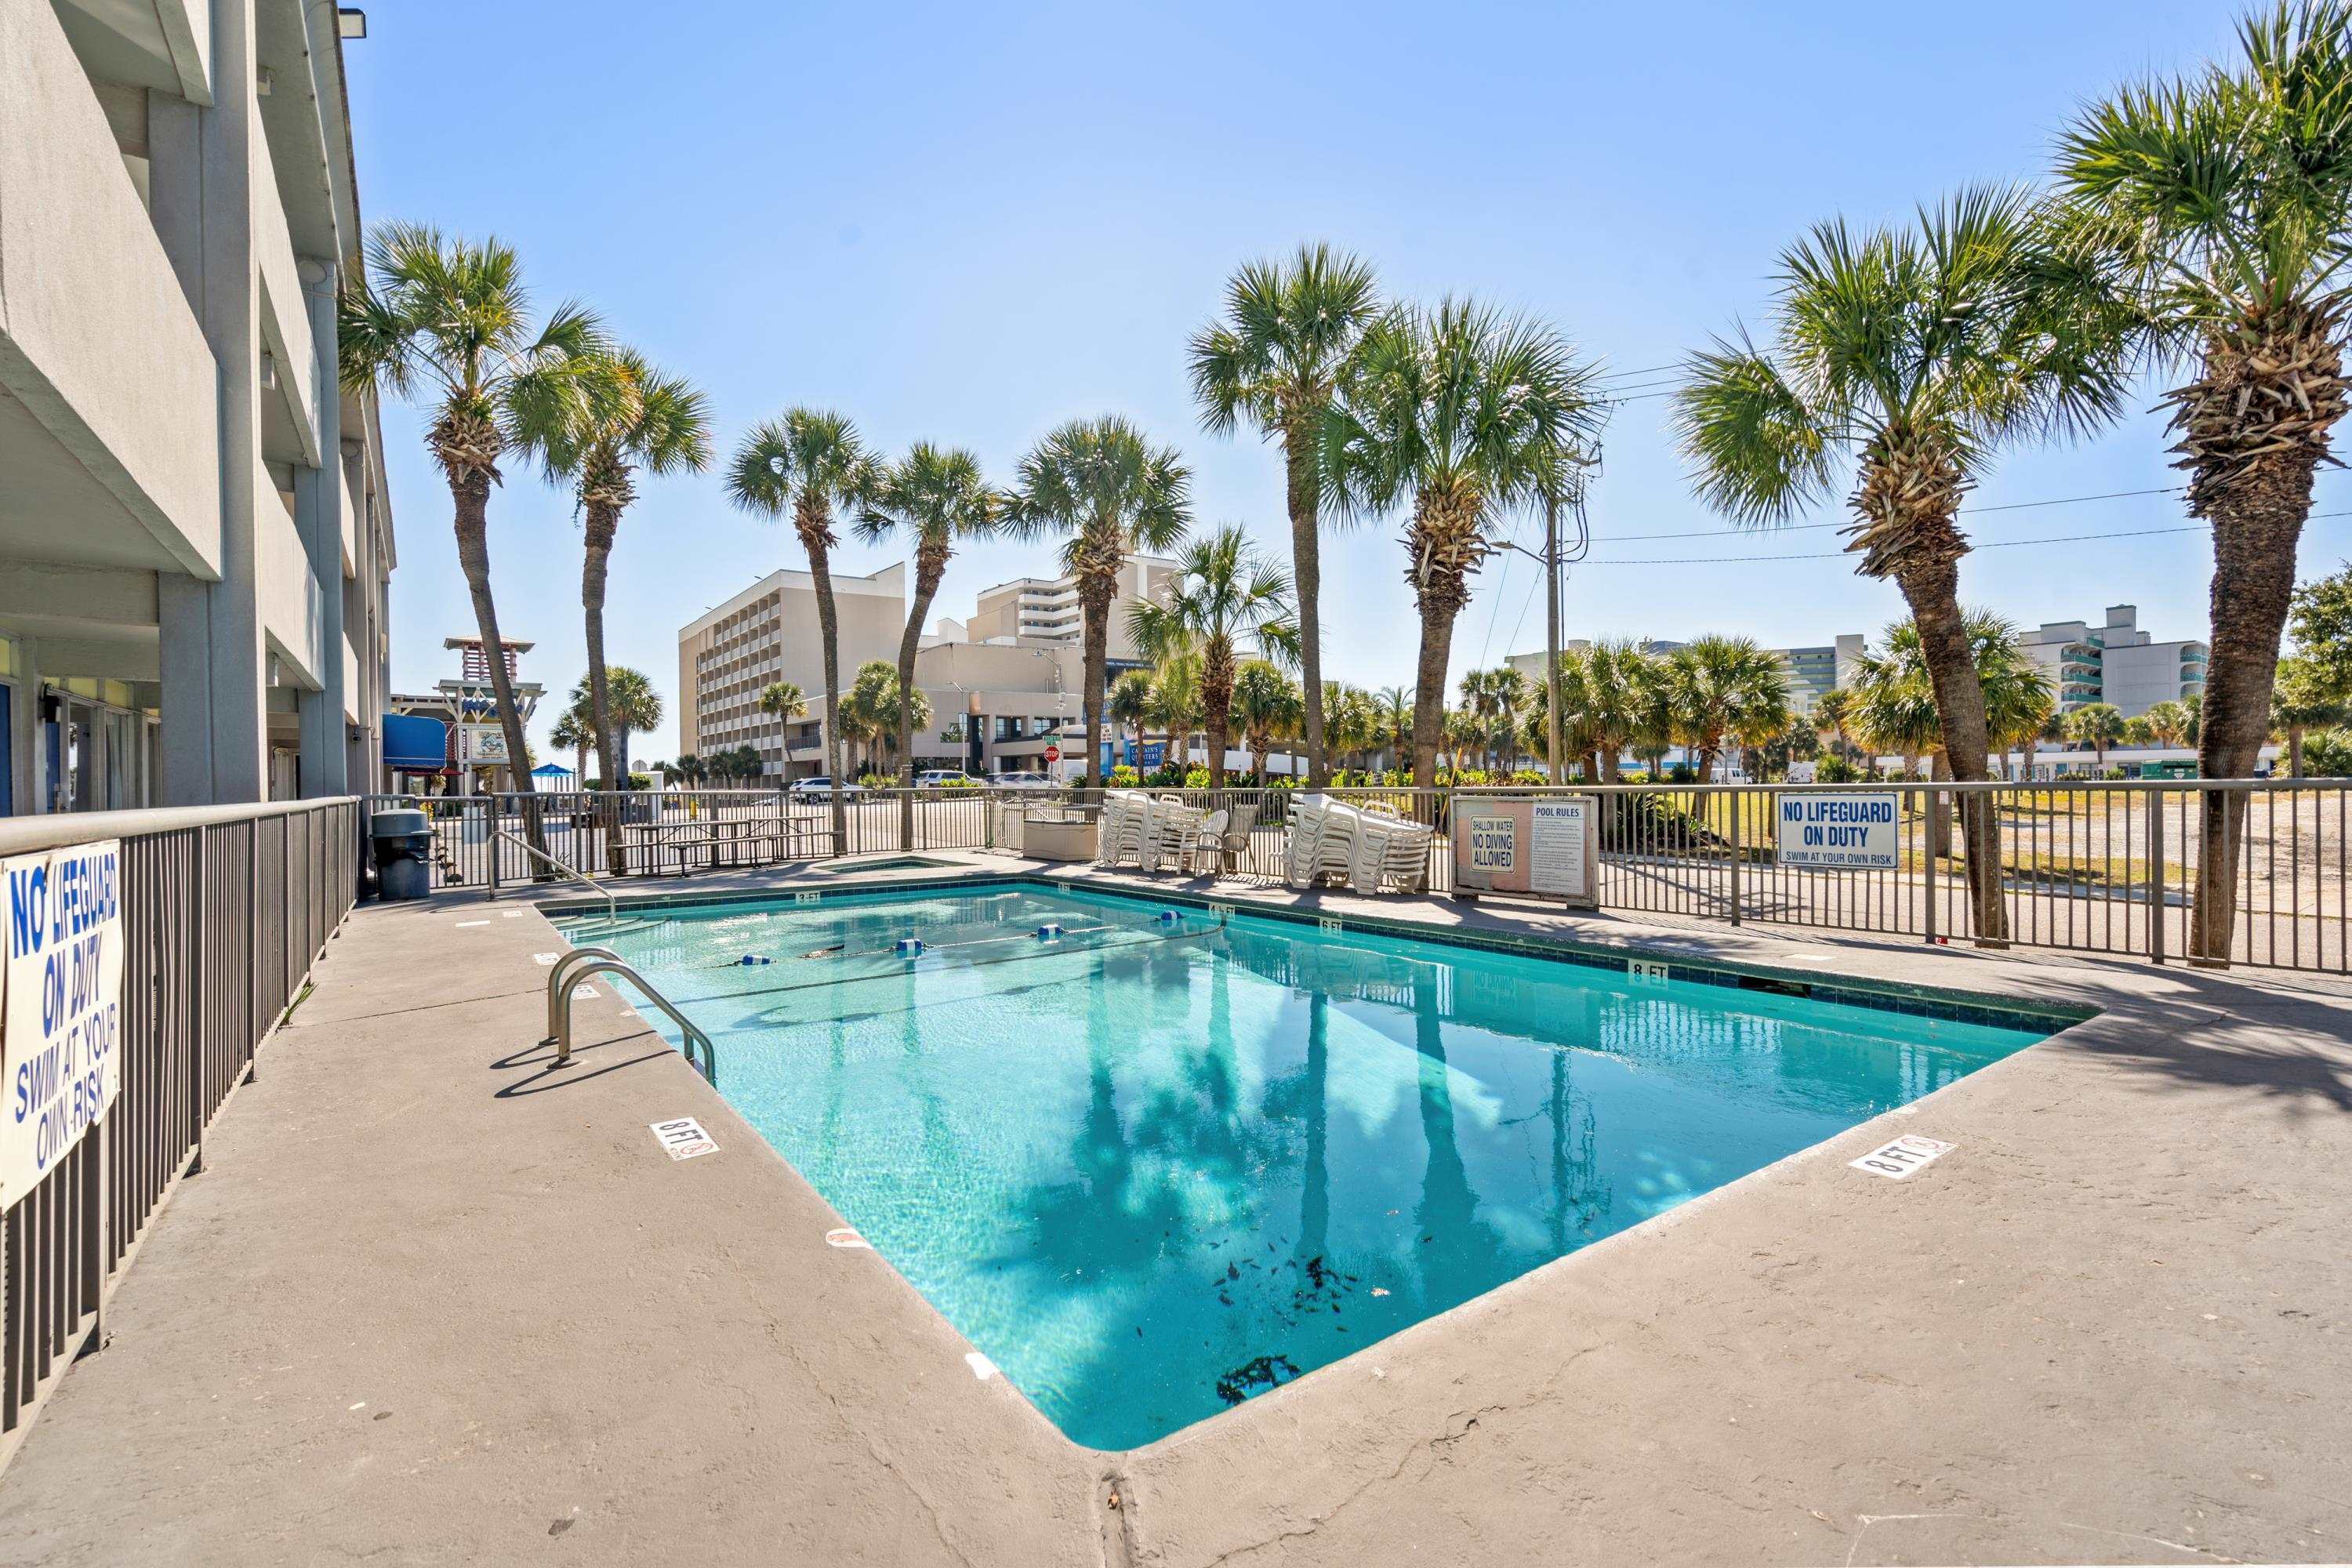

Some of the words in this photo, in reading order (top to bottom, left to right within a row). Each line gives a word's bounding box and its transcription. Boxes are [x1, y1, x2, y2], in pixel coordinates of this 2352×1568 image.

[1536, 808, 1554, 816] POOL
[1556, 808, 1579, 817] RULES
[1784, 801, 1802, 822] NO
[1807, 801, 1892, 823] LIFEGUARD
[1472, 821, 1494, 831] SHALLOW
[1496, 821, 1512, 831] WATER
[1472, 833, 1483, 848] NO
[1486, 834, 1512, 849] DIVING
[1804, 826, 1823, 846] ON
[1828, 826, 1868, 848] DUTY
[1474, 851, 1512, 866] ALLOWED
[1786, 851, 1808, 862] SWIM
[1811, 852, 1820, 862] AT
[1822, 852, 1845, 862] YOUR
[1848, 854, 1868, 864] OWN
[1871, 855, 1892, 865] RISK
[10, 865, 47, 960] NO
[53, 852, 116, 945] LIFEGUARD
[1331, 921, 1341, 930] FT
[1634, 964, 1642, 975] 8
[1650, 965, 1666, 978] FT
[43, 945, 65, 1039] ON
[70, 931, 103, 1020] DUTY
[15, 1040, 60, 1124] SWIM
[62, 1025, 78, 1086] AT
[84, 1003, 116, 1063] YOUR
[37, 1091, 68, 1170] OWN
[74, 1062, 104, 1133] RISK
[665, 1129, 704, 1144] FT
[1878, 1146, 1927, 1163] FT
[1864, 1160, 1904, 1172] 8
